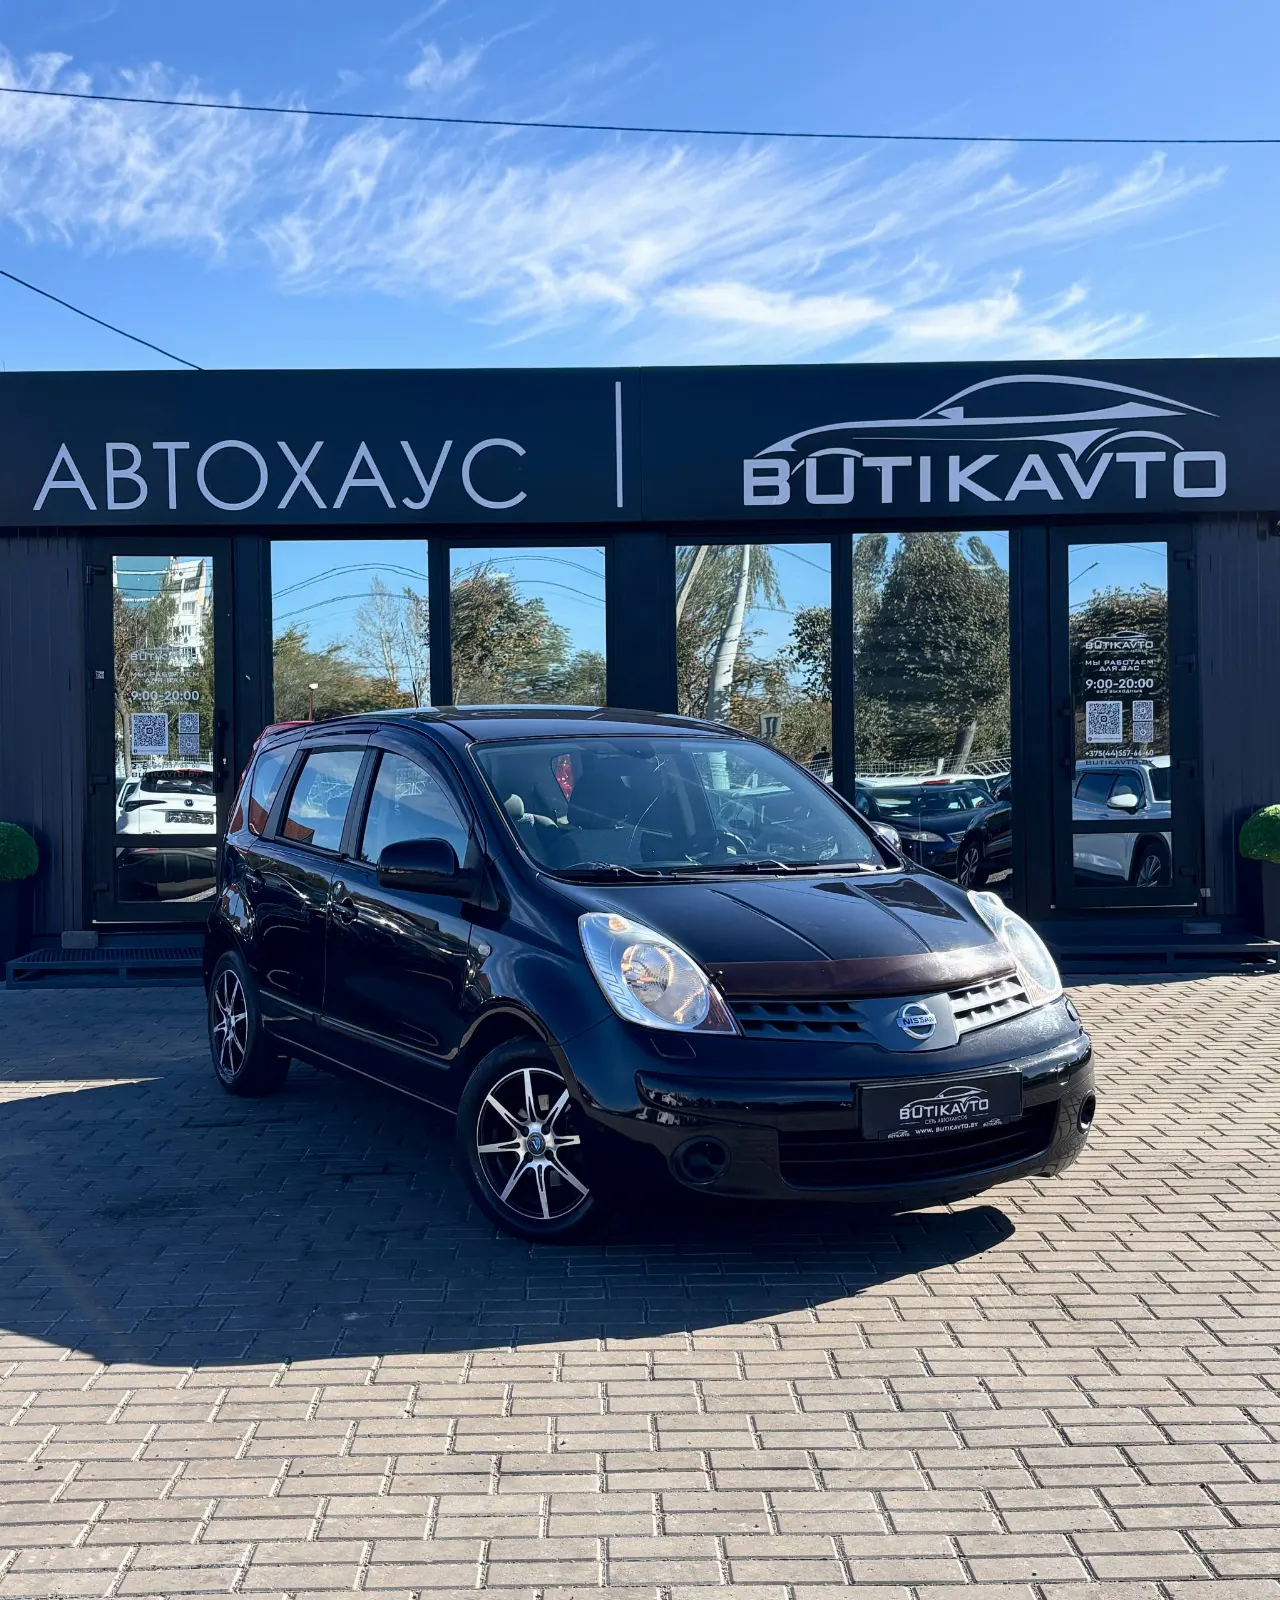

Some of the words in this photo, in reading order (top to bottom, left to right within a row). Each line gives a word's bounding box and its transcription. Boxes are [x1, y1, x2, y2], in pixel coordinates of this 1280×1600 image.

[33, 438, 527, 511] АВТОХАУС
[743, 450, 1227, 506] BUTIKAVTO
[1085, 641, 1154, 650] BUTIKAVTO
[1085, 678, 1154, 689] 9:00-20:00
[131, 690, 200, 701] 9:00-20:00
[902, 1016, 935, 1026] NISSAN
[900, 1099, 989, 1120] BUTIKAVTO
[935, 1121, 979, 1133] BUTIKAVTO.BY
